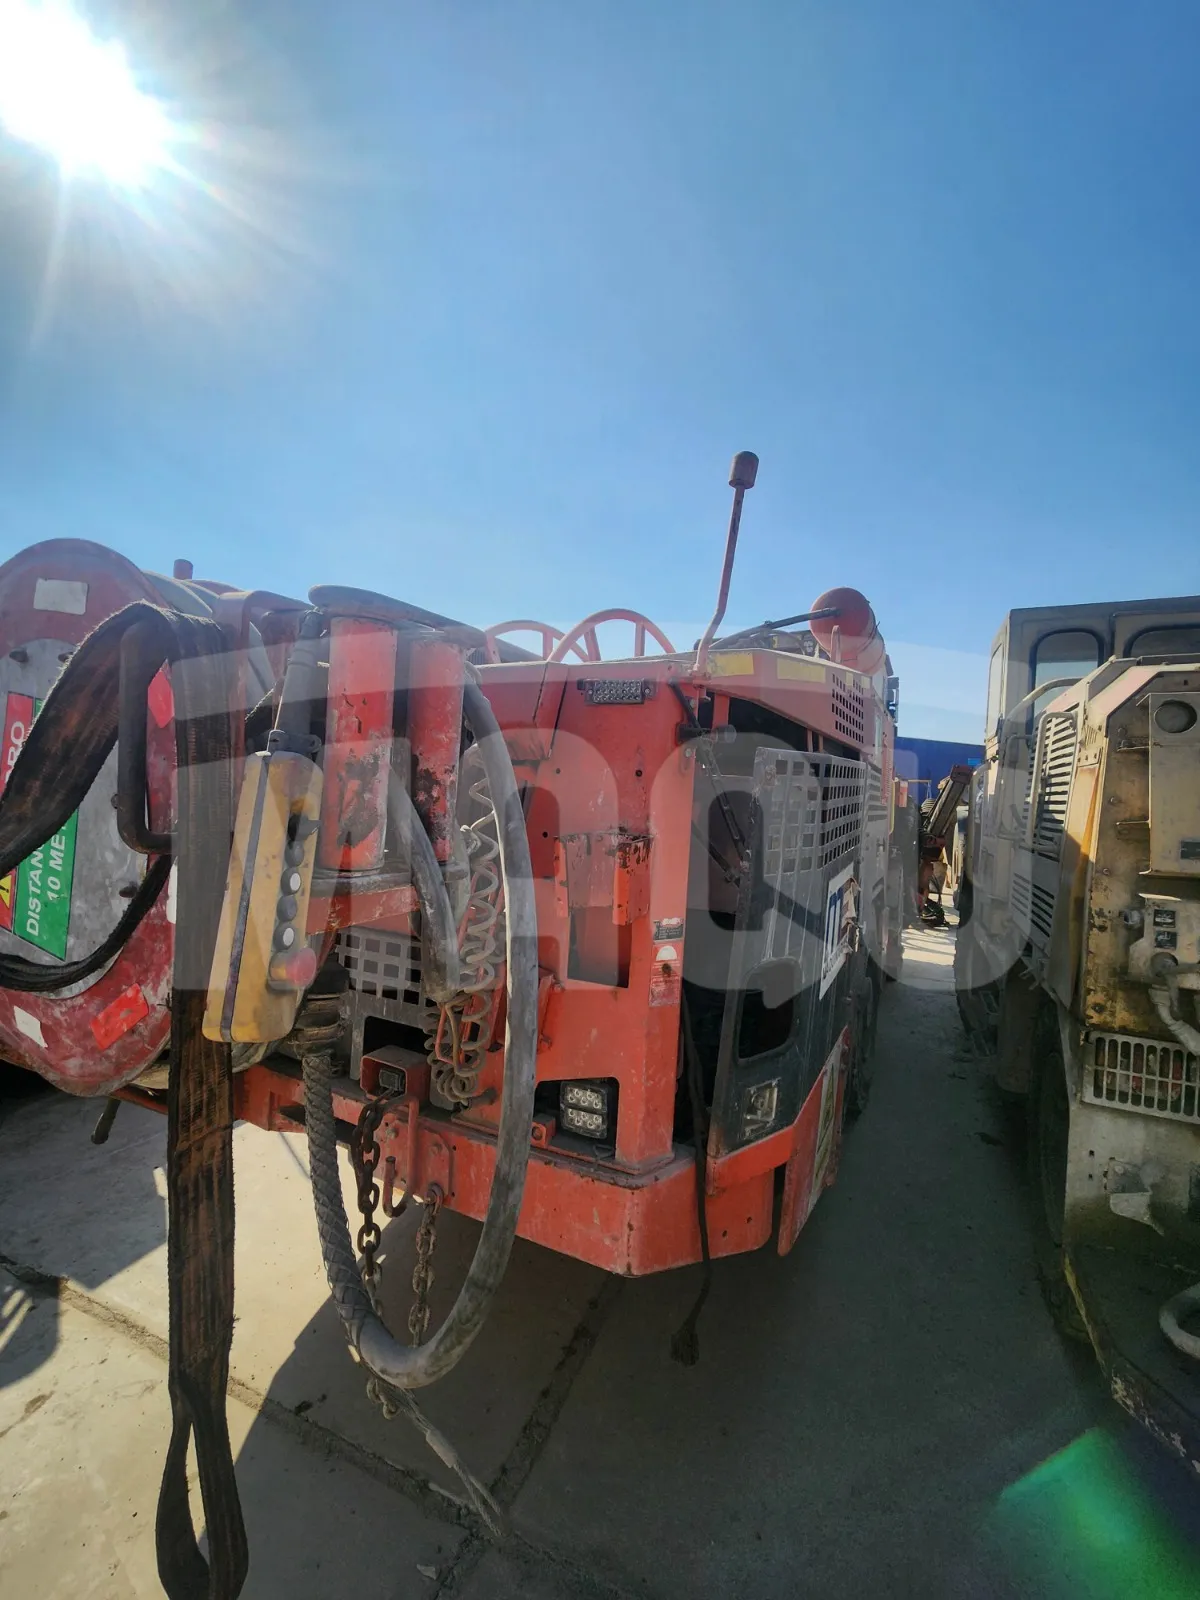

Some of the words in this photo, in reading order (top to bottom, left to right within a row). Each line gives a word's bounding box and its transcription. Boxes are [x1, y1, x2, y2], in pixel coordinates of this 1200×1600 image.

[49, 826, 66, 871] ME
[26, 844, 45, 937] DISTAN
[47, 876, 61, 903] 10
